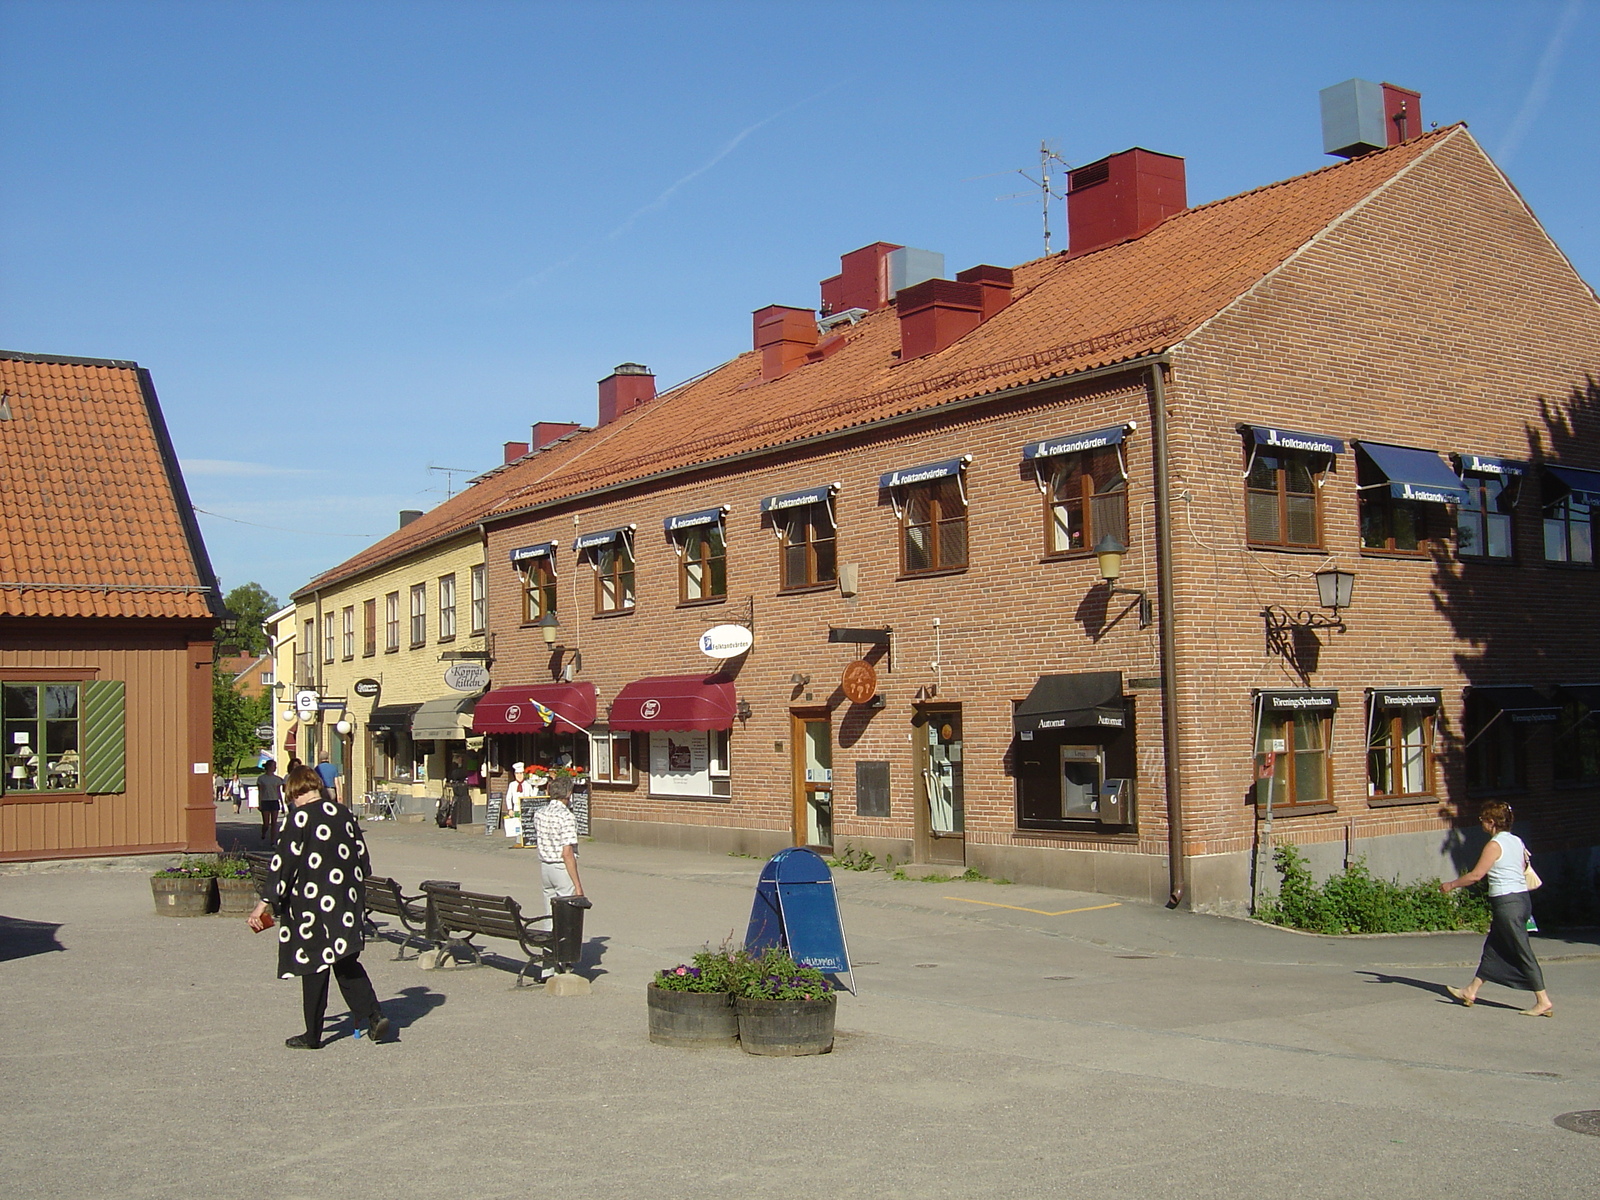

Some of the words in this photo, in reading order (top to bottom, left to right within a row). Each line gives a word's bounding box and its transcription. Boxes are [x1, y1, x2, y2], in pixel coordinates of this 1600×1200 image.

[1050, 437, 1107, 454] folktandvården
[1281, 437, 1333, 453] folktandvården
[901, 468, 948, 485] folktandvården
[778, 494, 819, 508] folktandvården
[301, 696, 311, 707] e
[1038, 718, 1066, 729] Automat
[1097, 715, 1123, 726] Automat
